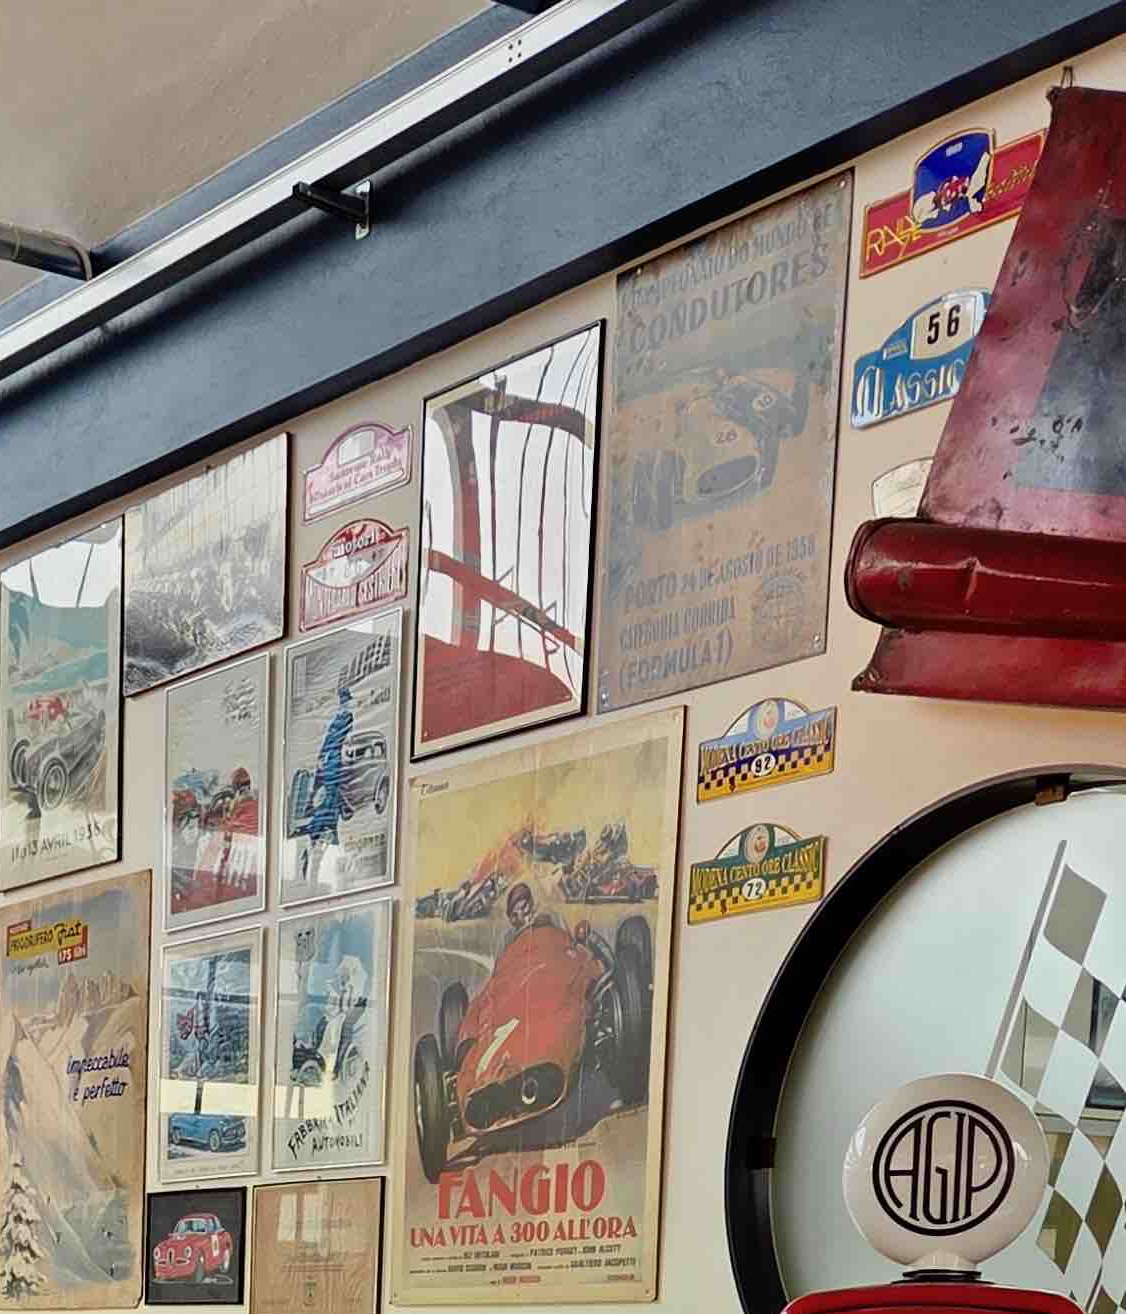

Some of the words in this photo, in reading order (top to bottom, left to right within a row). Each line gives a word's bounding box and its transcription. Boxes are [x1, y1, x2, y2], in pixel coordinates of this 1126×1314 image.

[927, 305, 961, 345] 56
[755, 755, 771, 773] 92
[746, 881, 763, 897] 72
[885, 1111, 1003, 1225] AGIP
[438, 1159, 606, 1219] FANGIO
[410, 1227, 446, 1248] UNA
[450, 1224, 488, 1247] VITA
[490, 1223, 506, 1244] A
[510, 1219, 550, 1244] 300
[553, 1215, 638, 1241] ALL'ORA
